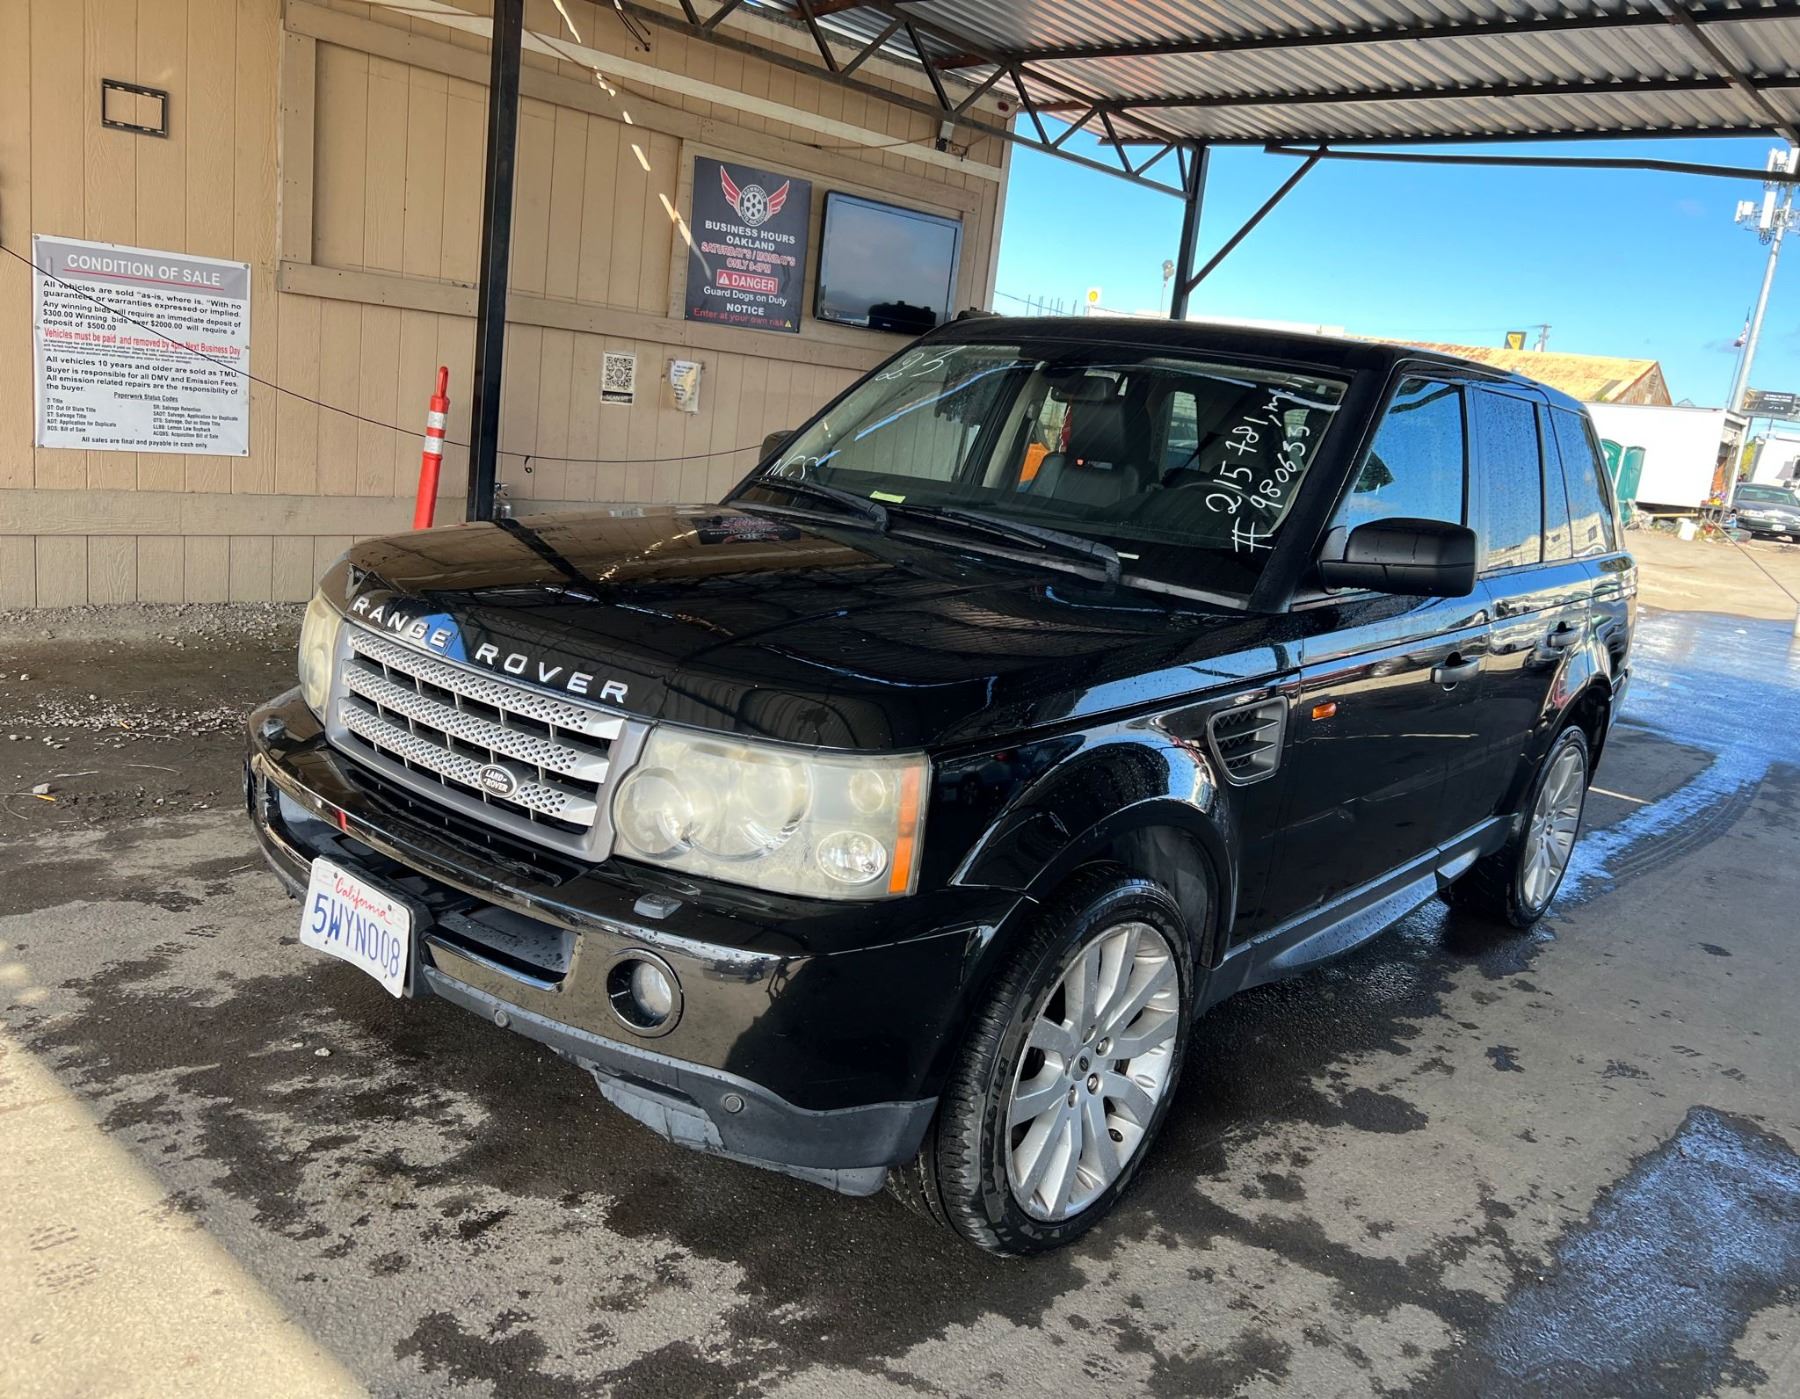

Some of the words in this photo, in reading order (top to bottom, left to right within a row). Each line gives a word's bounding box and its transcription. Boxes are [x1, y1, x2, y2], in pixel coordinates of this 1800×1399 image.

[705, 220, 758, 238] BUSINESS
[760, 230, 796, 245] HOURS
[726, 235, 775, 251] OAKLAND
[67, 254, 154, 277] CONDITION
[158, 266, 179, 280] OF
[183, 269, 221, 286] SALE
[726, 257, 749, 270] ONLY
[43, 280, 55, 288] All
[59, 283, 96, 292] vehicles
[115, 289, 134, 297] sold
[166, 296, 192, 304] where
[732, 275, 775, 291] DANGER
[43, 290, 94, 300] guarantees
[107, 297, 153, 307] warranties
[154, 302, 197, 313] expressed
[703, 286, 731, 298] Guard
[732, 290, 754, 302] Dogs
[755, 294, 767, 302] on
[768, 295, 788, 307] Duty
[43, 300, 59, 309] Any
[61, 303, 92, 313] winning
[94, 305, 111, 314] bids
[127, 310, 154, 319] require
[167, 314, 205, 323] immediate
[206, 318, 232, 327] deposit
[694, 307, 718, 318] Enter
[719, 310, 729, 319] at
[730, 313, 750, 322] your
[750, 315, 768, 324] own
[769, 317, 785, 327] risk
[726, 302, 765, 316] NOTICE
[43, 309, 73, 318] $300.00
[75, 312, 107, 323] Winning
[111, 316, 128, 324] bids
[151, 320, 182, 330] $2000.00
[202, 327, 228, 335] require
[43, 318, 73, 327] deposit
[87, 322, 116, 331] $500.00
[44, 327, 73, 339] Vehicles
[74, 331, 91, 340] must
[92, 332, 100, 341] be
[102, 333, 116, 343] paid
[119, 336, 131, 344] and
[132, 337, 160, 347] removed
[161, 340, 169, 350] by
[185, 341, 200, 351] Next
[200, 343, 228, 354] Business
[229, 345, 240, 357] Day
[60, 357, 96, 366] vehicles
[134, 363, 150, 371] and
[152, 365, 173, 373] older
[46, 366, 70, 375] Buyer
[81, 369, 126, 378] responsible
[127, 371, 139, 379] for
[151, 374, 169, 382] DMV
[186, 377, 219, 386] Emission
[59, 376, 95, 384] emission
[96, 378, 123, 386] related
[181, 385, 229, 395] responsibility
[352, 596, 453, 648] RANGE
[475, 642, 630, 703] ROVER
[485, 769, 504, 781] LAND
[485, 778, 508, 793] ROVER
[335, 877, 393, 926] California
[312, 893, 401, 977] 5WYN008
